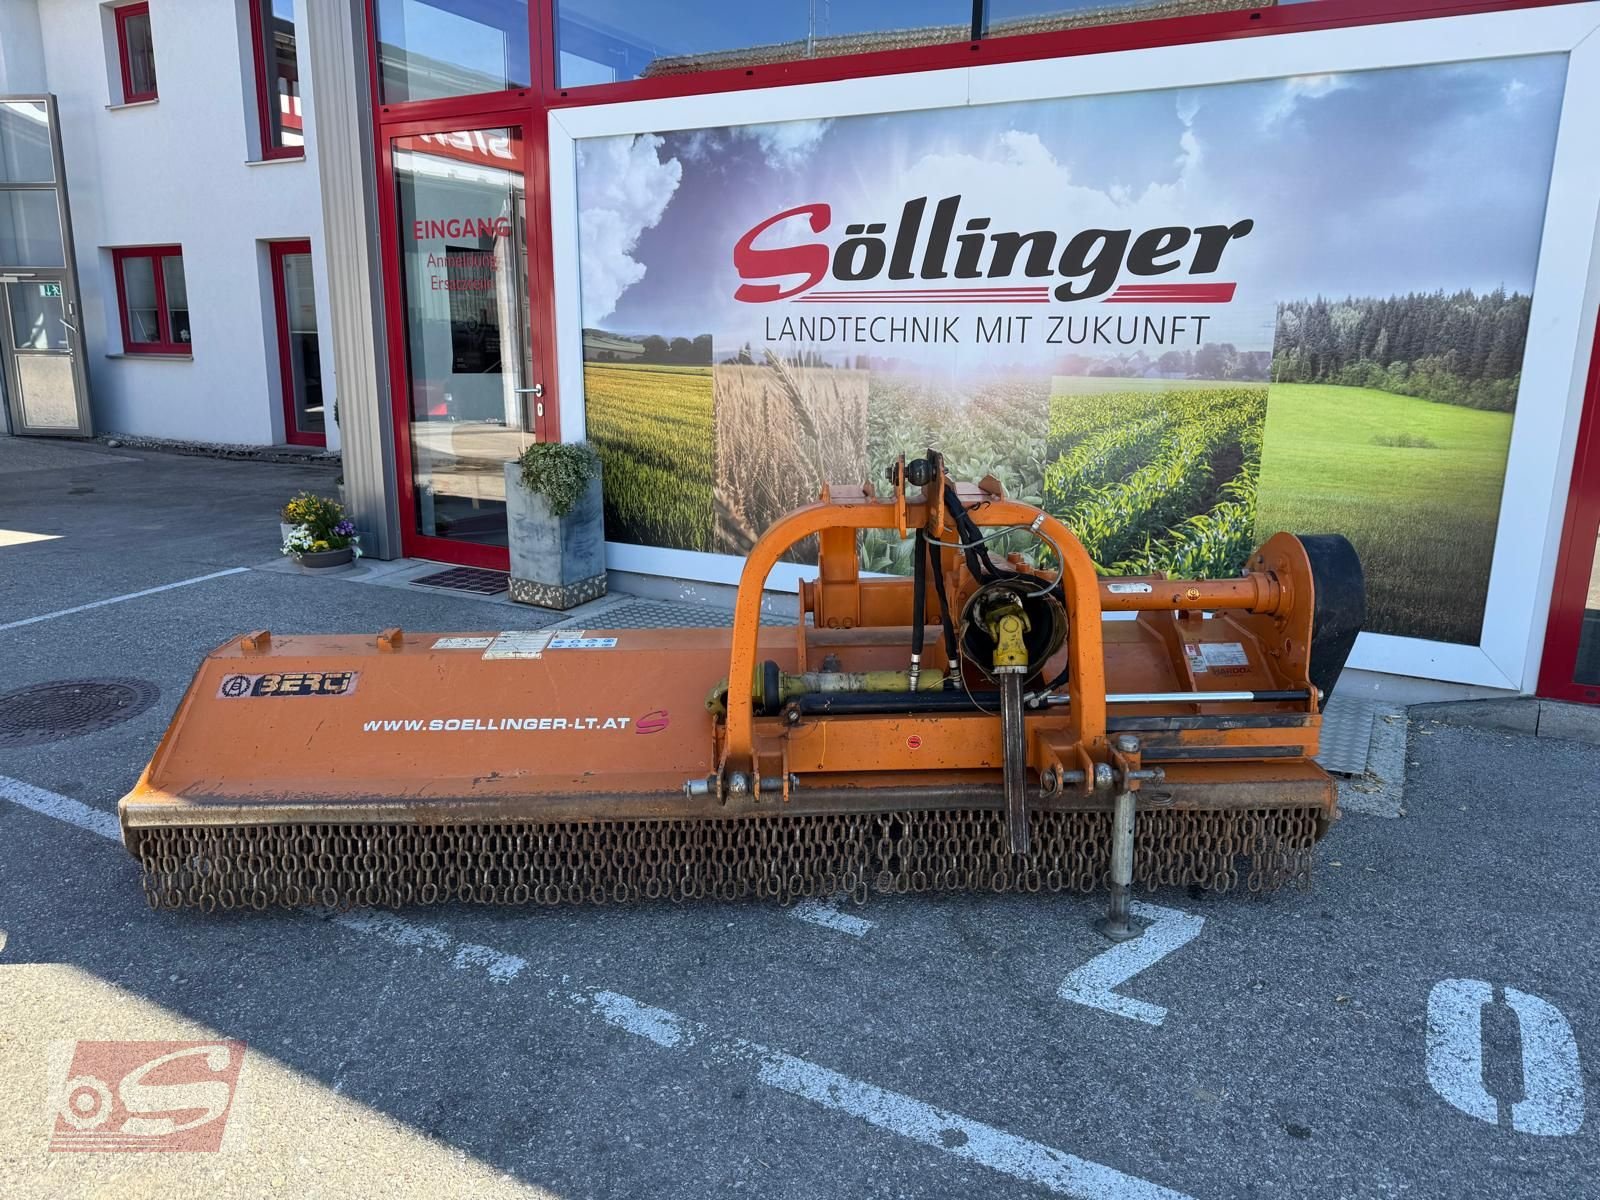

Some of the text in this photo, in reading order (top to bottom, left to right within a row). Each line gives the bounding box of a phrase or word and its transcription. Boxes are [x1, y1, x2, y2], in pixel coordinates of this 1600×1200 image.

[413, 217, 512, 240] EINGANG
[734, 194, 1253, 303] Söllinger
[765, 315, 1211, 345] LANDTECHNIK MIT ZUKUNFT
[363, 717, 631, 732] WWW.SOELLINGER-LT.AT
